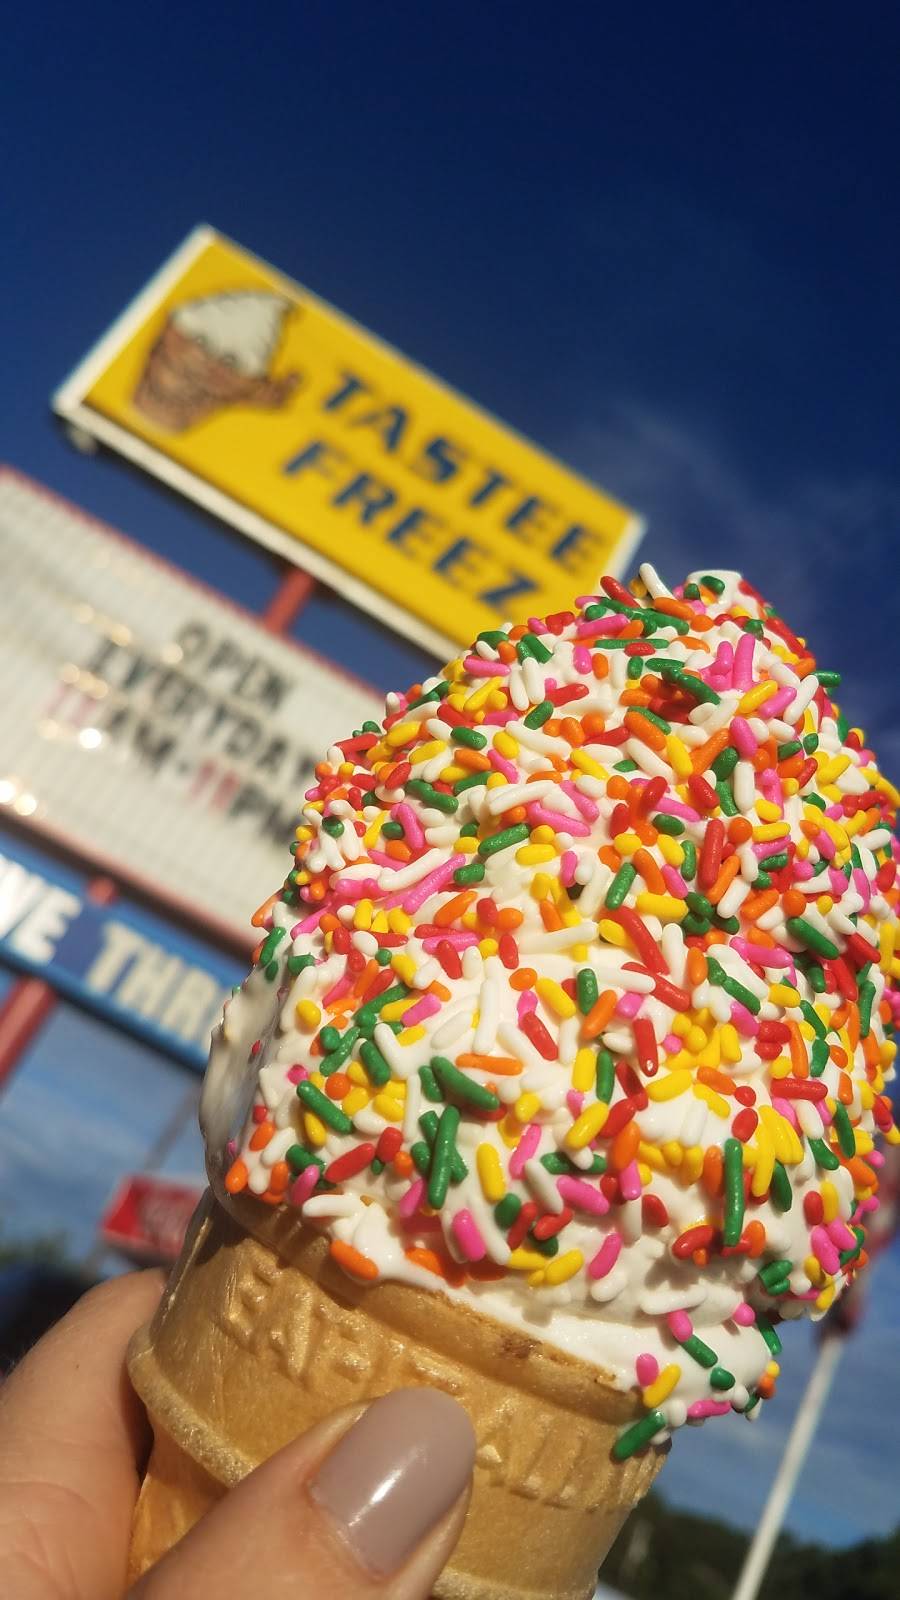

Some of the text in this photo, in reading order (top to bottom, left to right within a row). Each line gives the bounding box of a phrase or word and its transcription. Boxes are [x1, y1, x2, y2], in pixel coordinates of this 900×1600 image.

[281, 440, 541, 618] FREEZ
[323, 371, 608, 575] TASTEE
[177, 618, 293, 714] OPEN
